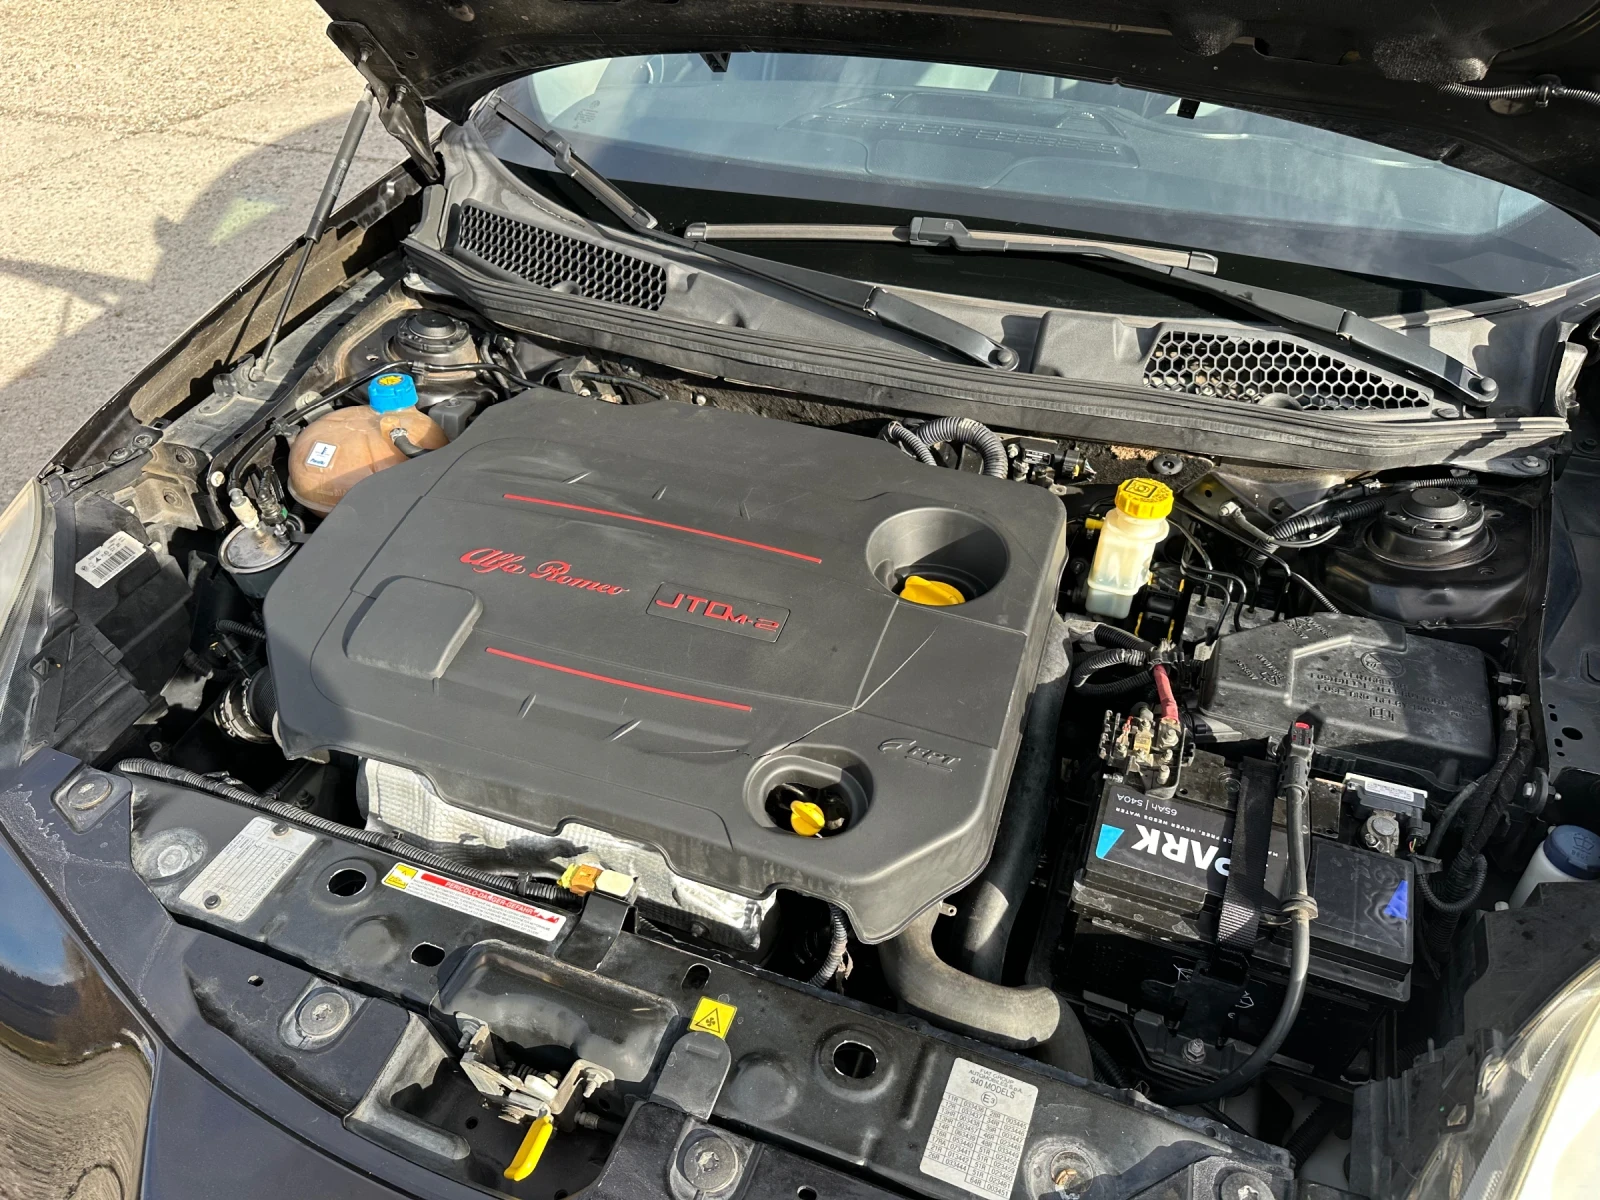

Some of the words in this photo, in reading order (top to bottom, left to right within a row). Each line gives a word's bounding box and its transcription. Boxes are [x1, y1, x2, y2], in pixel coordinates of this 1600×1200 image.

[460, 548, 526, 579] Alfa
[529, 560, 629, 596] Romeo
[1116, 793, 1143, 808] 540A
[1115, 807, 1140, 818] WATER
[1151, 803, 1177, 817] 65Ah
[1171, 822, 1196, 833] NEVER
[967, 1069, 1008, 1087] AUTOMOBILES
[979, 1068, 991, 1076] FIAT
[992, 1073, 1014, 1084] GROUP
[969, 1076, 984, 1086] 940
[983, 1081, 1015, 1099] MODELS
[947, 1094, 958, 1102] 11R
[937, 1122, 949, 1130] 14R
[983, 1132, 995, 1140] 46R
[930, 1144, 942, 1152] 21R
[974, 1161, 986, 1170] 51R
[949, 1143, 971, 1155] 073441
[976, 1154, 988, 1162] 51R
[978, 1147, 990, 1155] 51R
[971, 1169, 984, 1177] 51R
[969, 1177, 981, 1186] 64R
